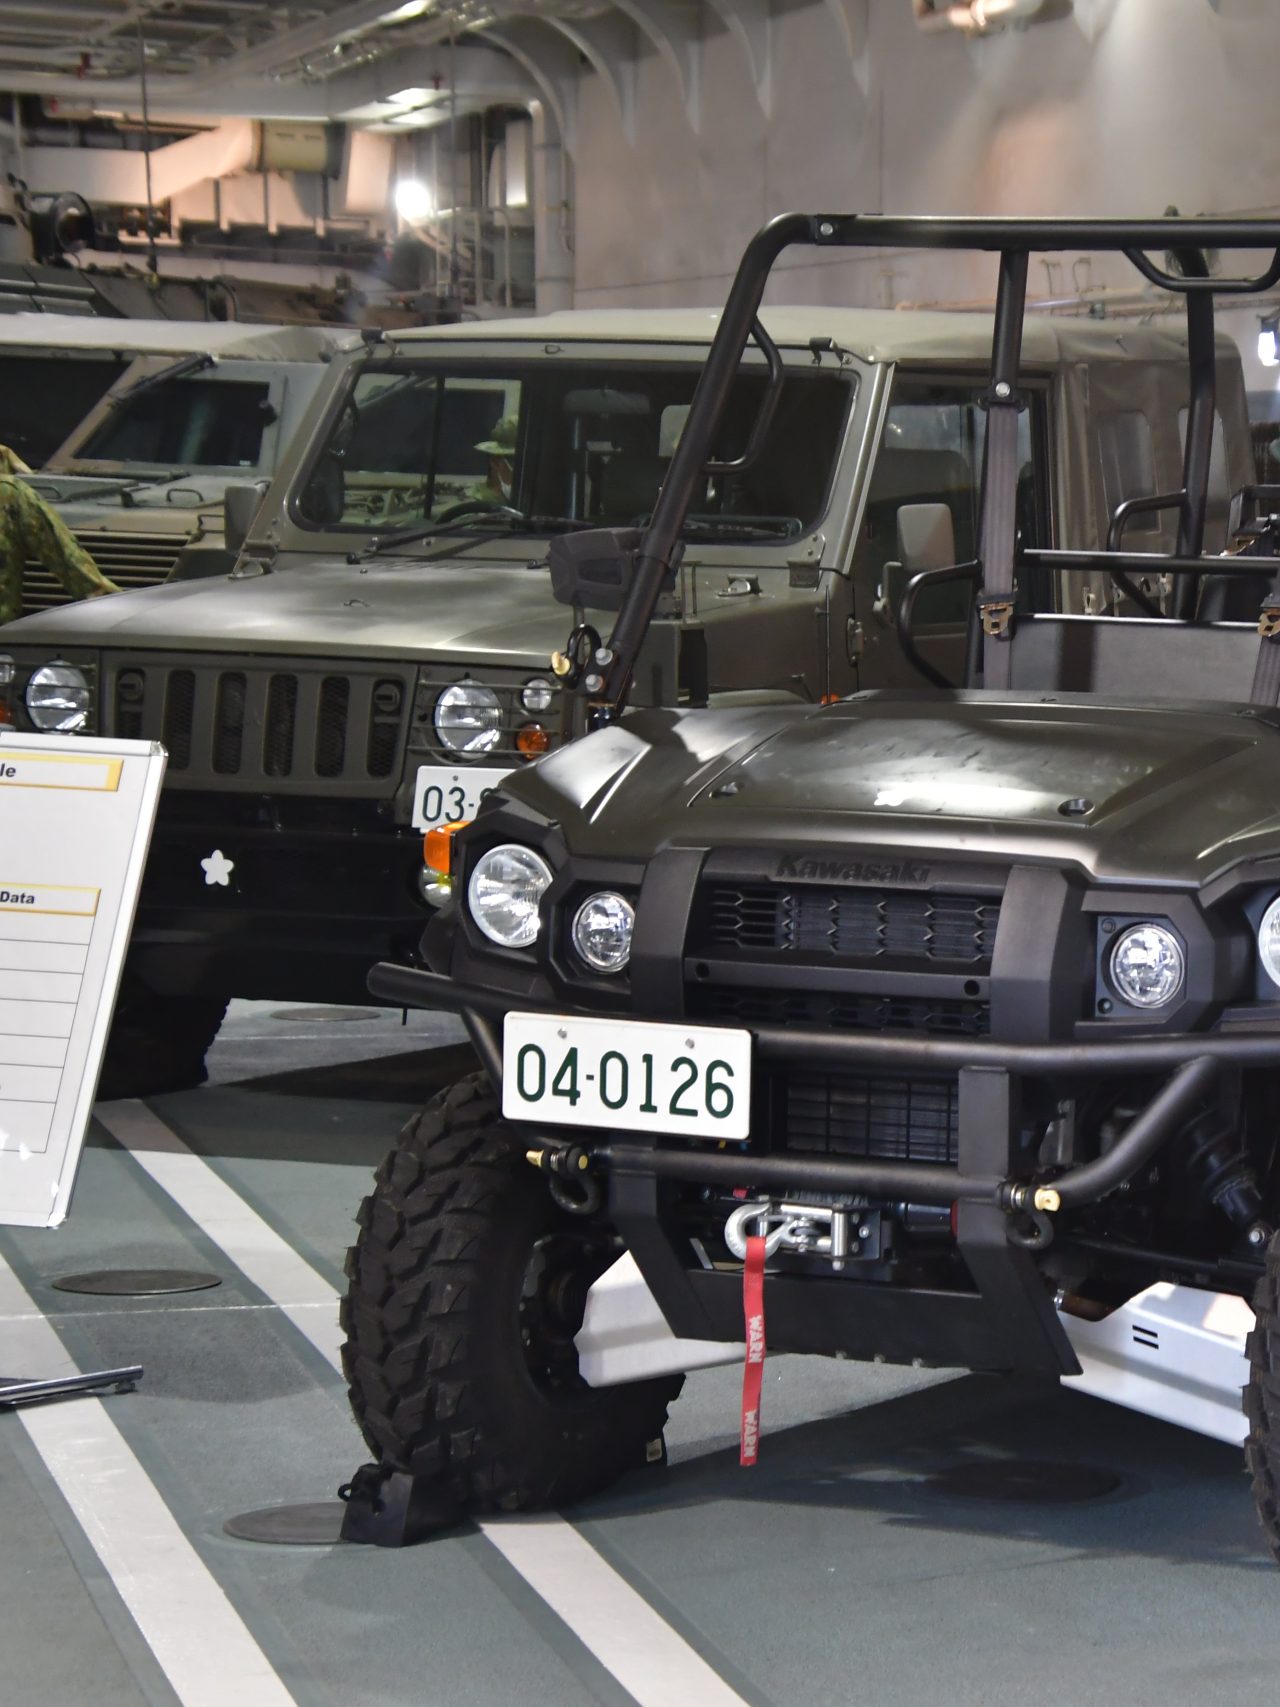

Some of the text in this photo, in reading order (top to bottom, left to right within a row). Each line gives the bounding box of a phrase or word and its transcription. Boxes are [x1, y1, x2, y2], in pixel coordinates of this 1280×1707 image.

[775, 854, 932, 883] Kawasaki
[0, 890, 36, 904] Data
[517, 1043, 735, 1119] 04-0126
[749, 1314, 763, 1363] WARN
[743, 1409, 757, 1457] WARN
